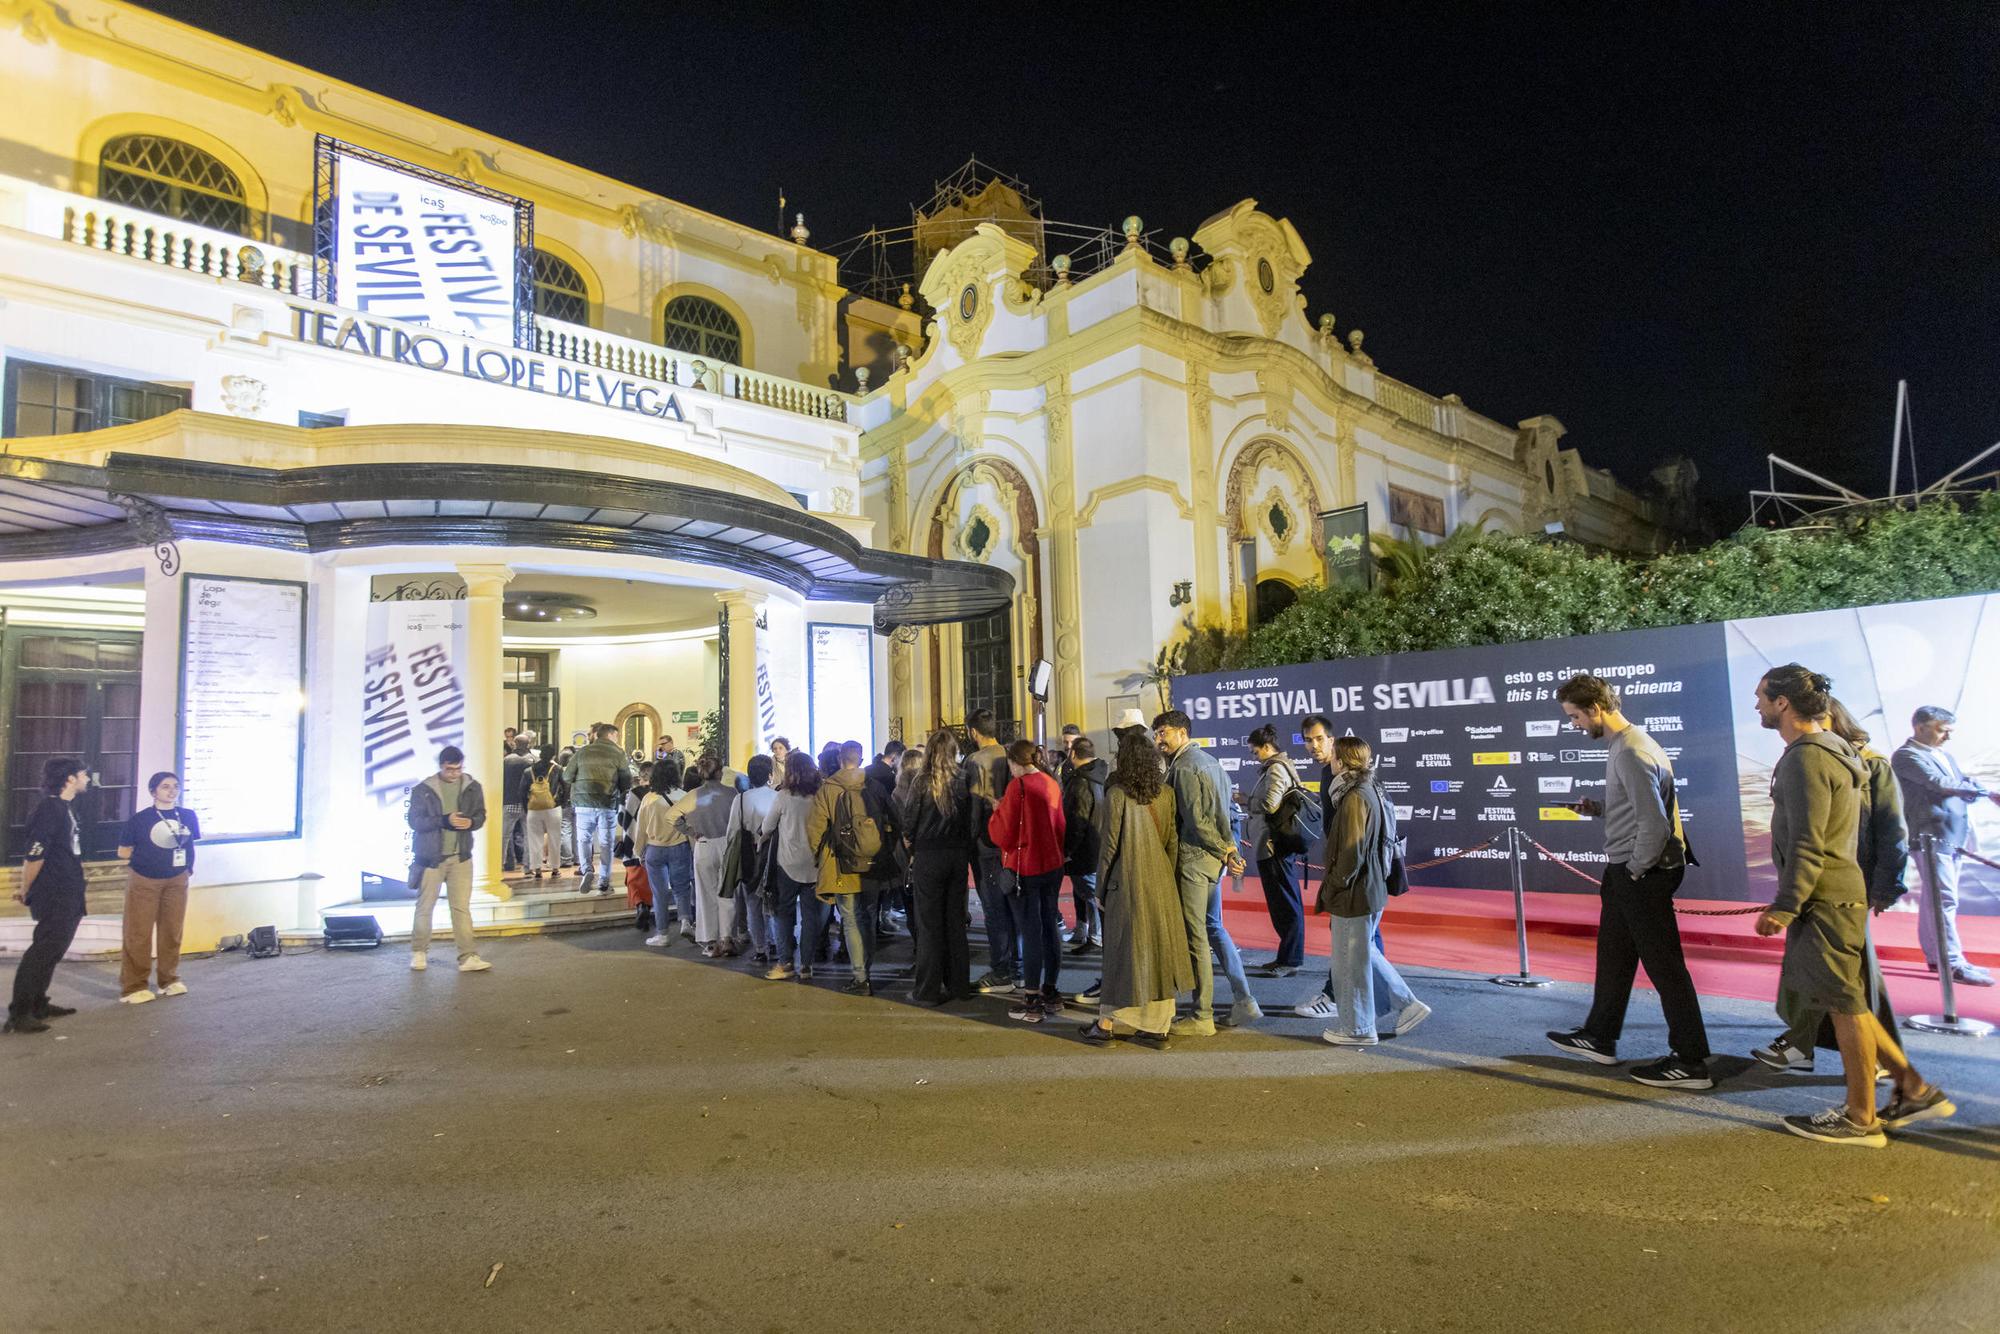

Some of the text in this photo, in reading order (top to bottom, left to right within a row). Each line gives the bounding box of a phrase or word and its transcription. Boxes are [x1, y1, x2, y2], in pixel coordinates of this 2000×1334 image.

[353, 223, 431, 322] SEVIL
[420, 213, 512, 330] FESTIVA
[288, 304, 685, 422] TEATRO LOPE DE VEGA
[1215, 677, 1279, 691] 4-12 NOV 2022
[1504, 671, 1534, 685] esto
[1537, 670, 1554, 682] es
[1592, 663, 1656, 680] europeo
[408, 643, 464, 747] FESTIV
[1182, 676, 1497, 720] 19 FESTIVAL DE SEVILLA
[1506, 688, 1533, 703] this
[1536, 687, 1553, 701] is
[1623, 679, 1683, 696] cinema
[756, 662, 775, 746] FESTIV
[1470, 725, 1503, 734] Sabadell
[1643, 716, 1683, 726] FESTIVAL
[1648, 723, 1684, 733] SEVILLA
[1416, 760, 1425, 768] DE
[1422, 753, 1452, 761] FESTIVAL
[1434, 846, 1528, 861] #19FstivalSeva
